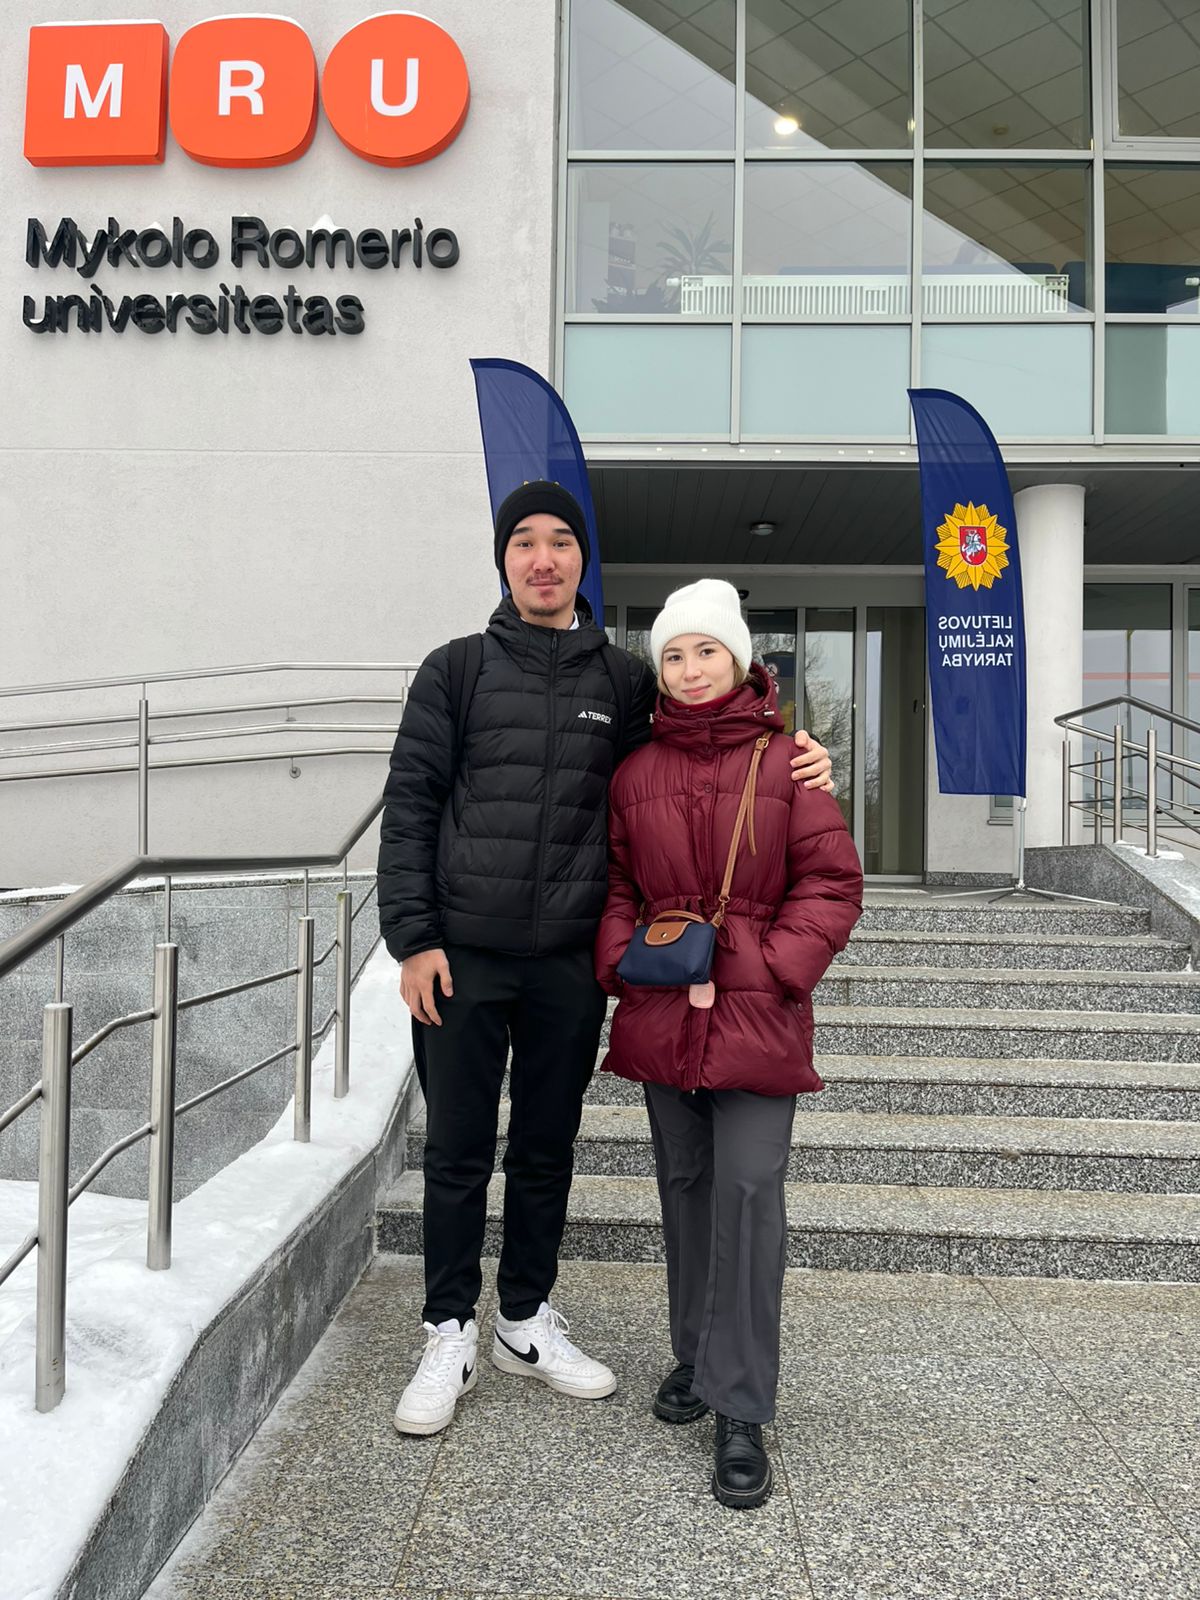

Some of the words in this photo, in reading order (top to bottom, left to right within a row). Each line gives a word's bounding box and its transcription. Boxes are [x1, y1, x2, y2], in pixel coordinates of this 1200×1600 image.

[25, 215, 220, 278] Mykolo
[230, 214, 460, 270] Romerio
[22, 283, 365, 336] universitetas
